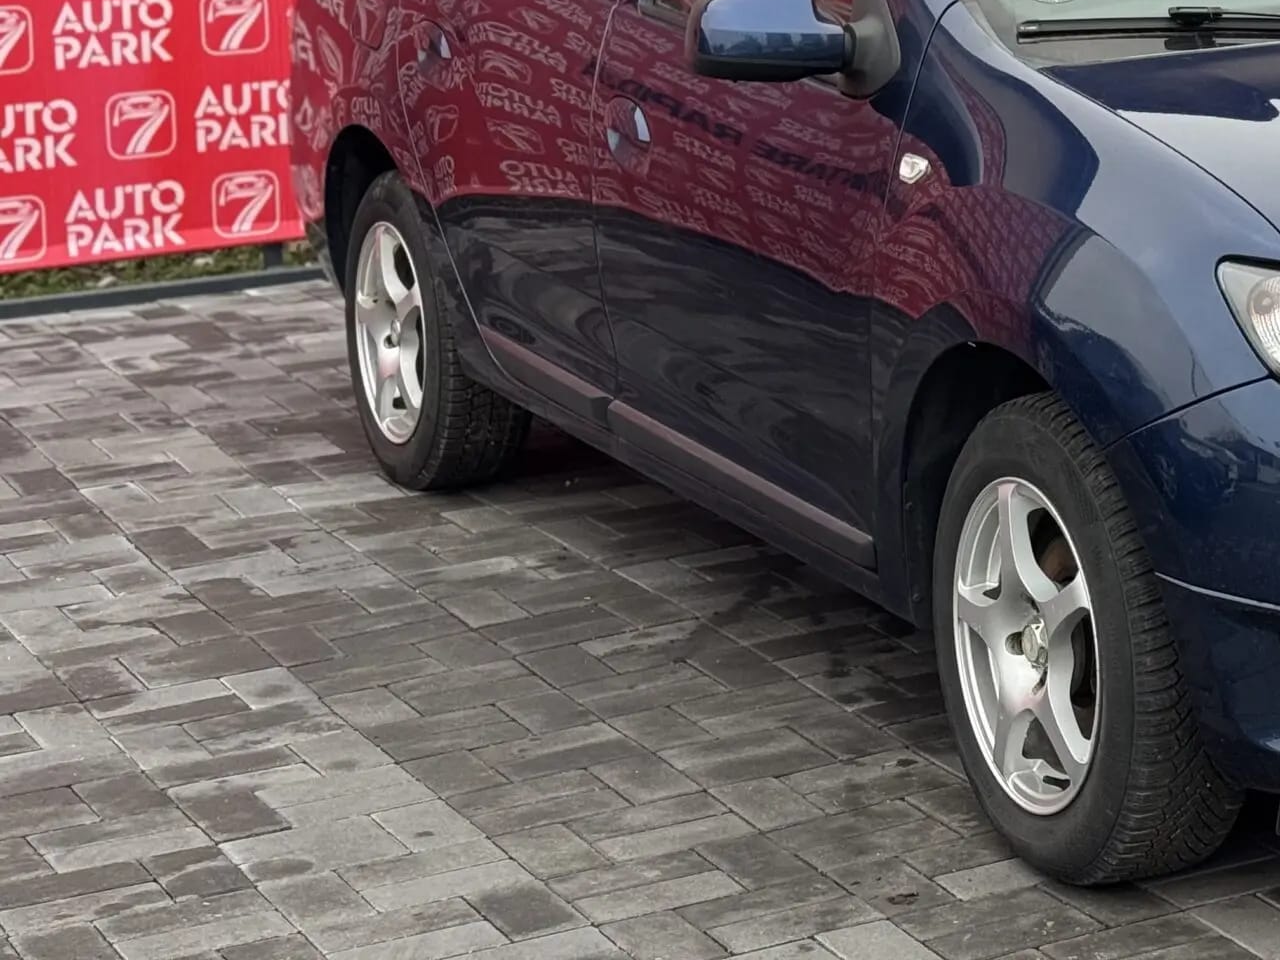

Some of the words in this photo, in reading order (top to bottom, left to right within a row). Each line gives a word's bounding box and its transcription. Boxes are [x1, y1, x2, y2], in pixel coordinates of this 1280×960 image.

[54, 27, 173, 70] PARK
[65, 179, 185, 223] AUTO
[67, 213, 186, 257] PARK
